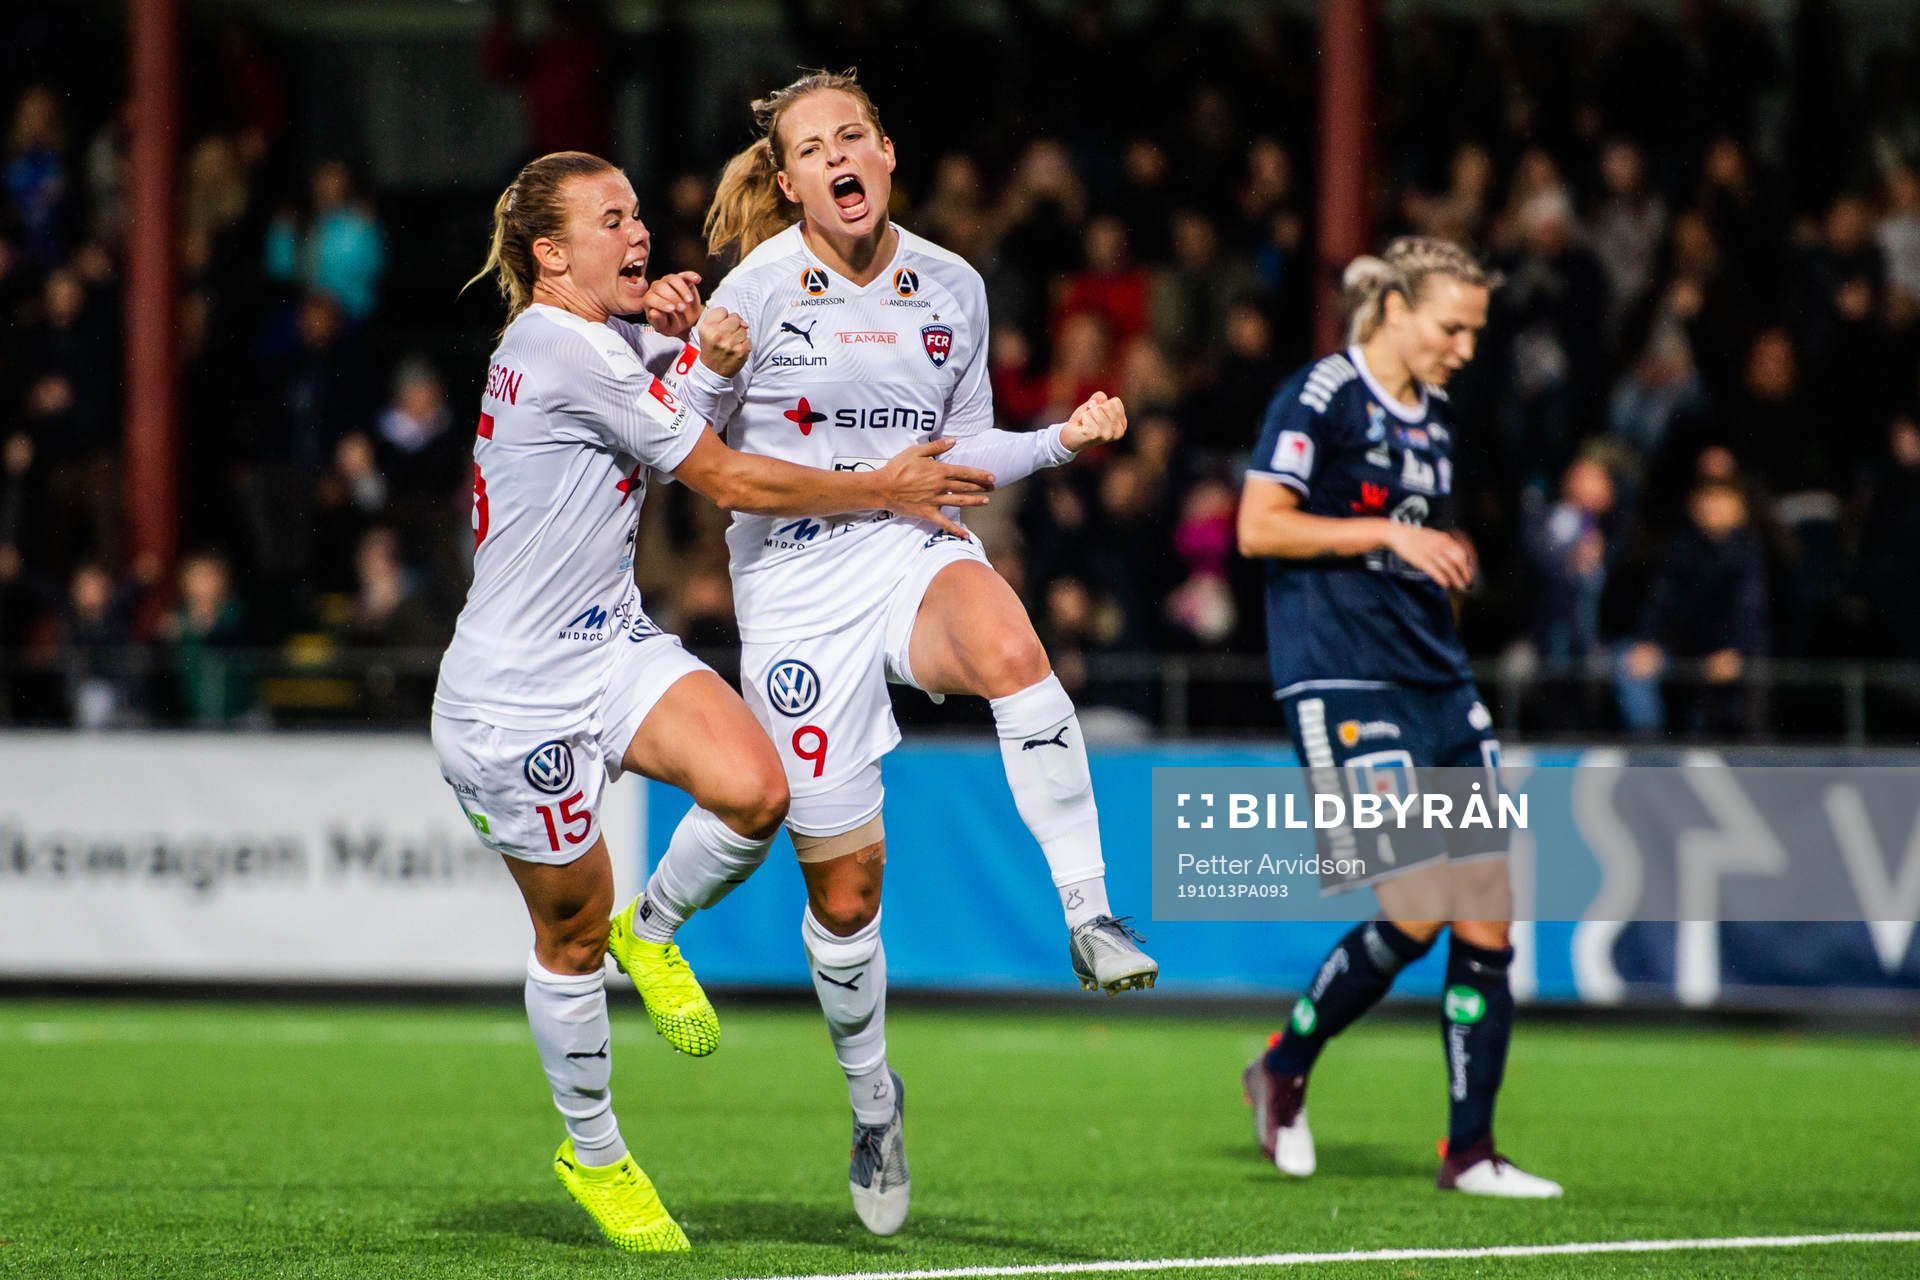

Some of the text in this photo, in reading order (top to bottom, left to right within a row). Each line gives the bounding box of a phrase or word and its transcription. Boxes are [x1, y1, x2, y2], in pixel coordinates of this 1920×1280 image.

[926, 334, 950, 347] FCR
[771, 355, 828, 367] stadium
[558, 631, 604, 642] MIDROC
[791, 725, 828, 778] 9
[535, 789, 592, 852] 15
